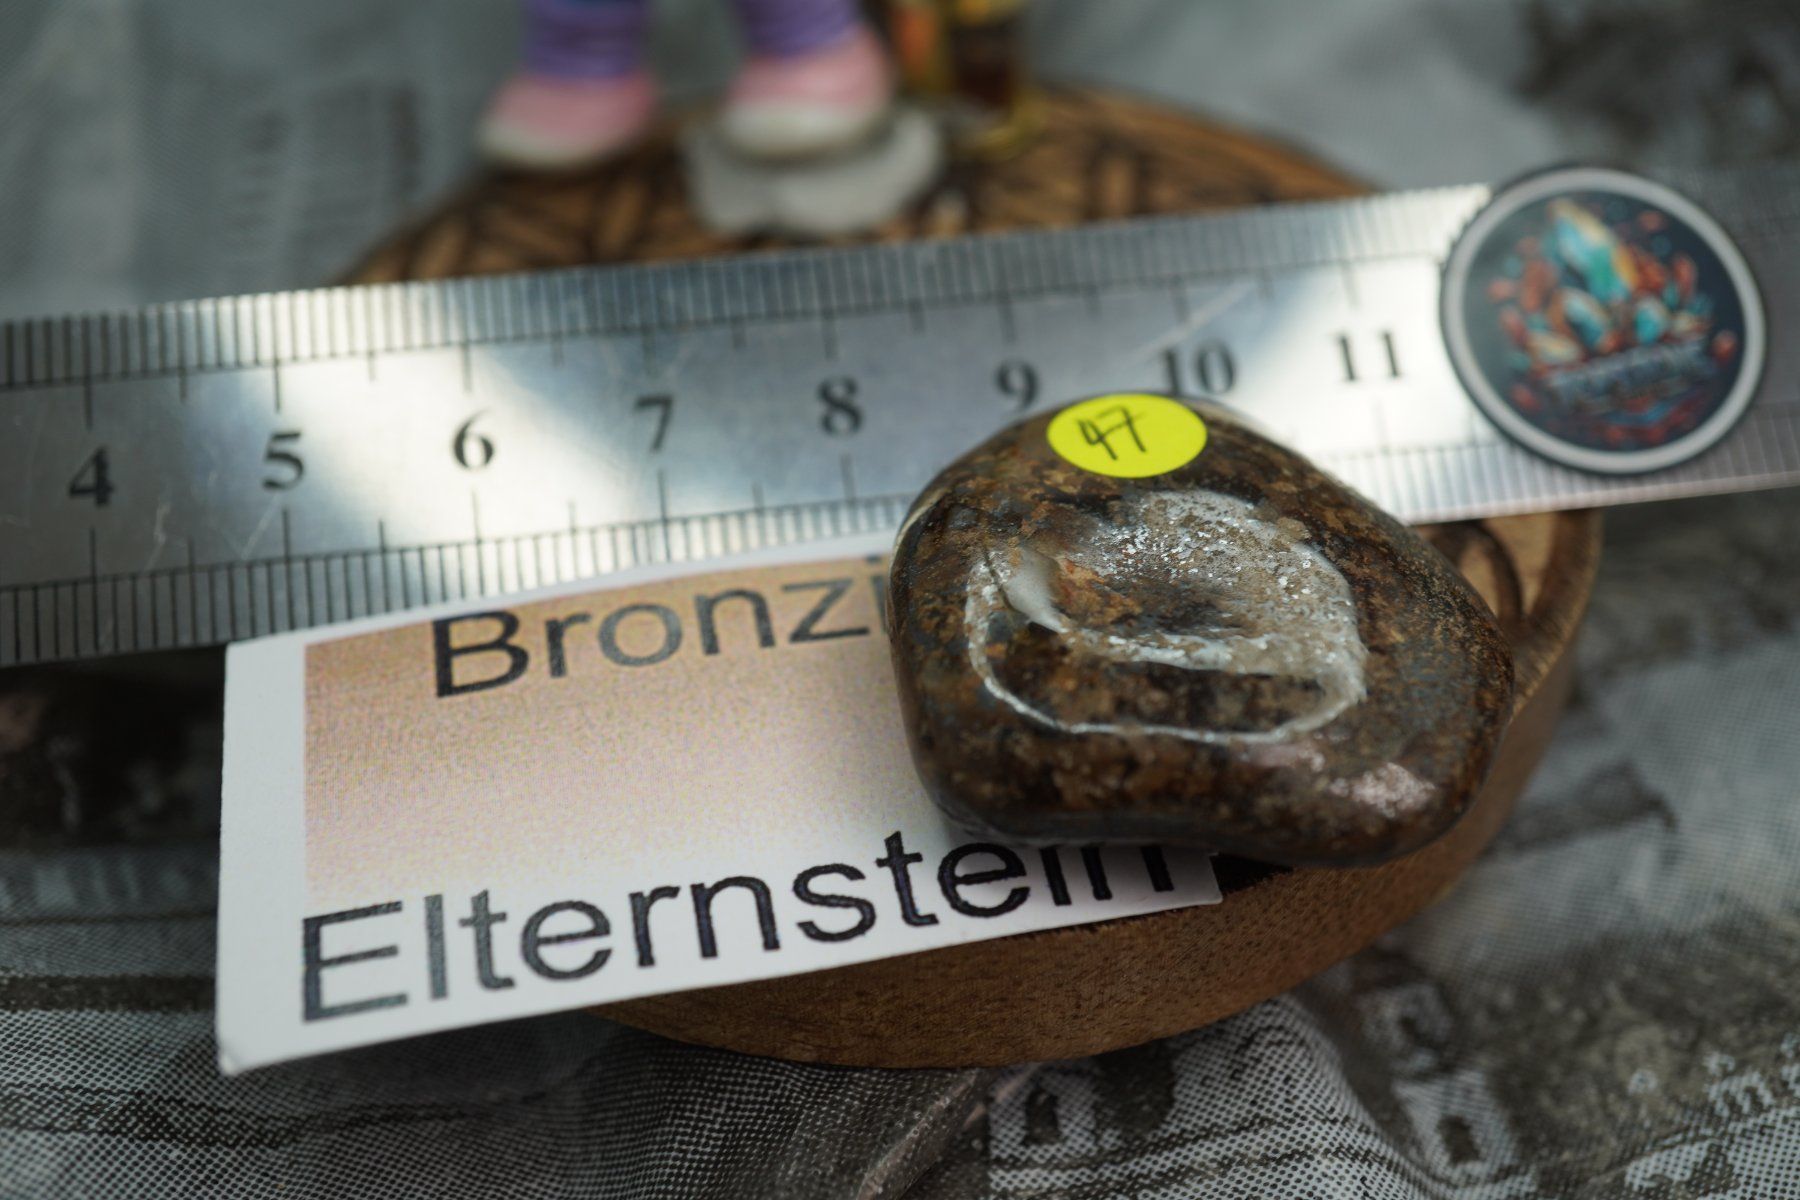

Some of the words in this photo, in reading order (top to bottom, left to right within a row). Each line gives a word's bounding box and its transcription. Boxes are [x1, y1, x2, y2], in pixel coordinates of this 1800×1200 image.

[68, 447, 115, 507] 4
[262, 430, 304, 491] 5
[453, 409, 495, 472] 6
[634, 394, 674, 454] 7
[816, 375, 863, 437] 8
[994, 359, 1040, 411] 9
[1159, 344, 1238, 397] 10
[1335, 331, 1402, 383] 11
[1075, 404, 1148, 461] 47
[302, 830, 1175, 1024] Elternstein
